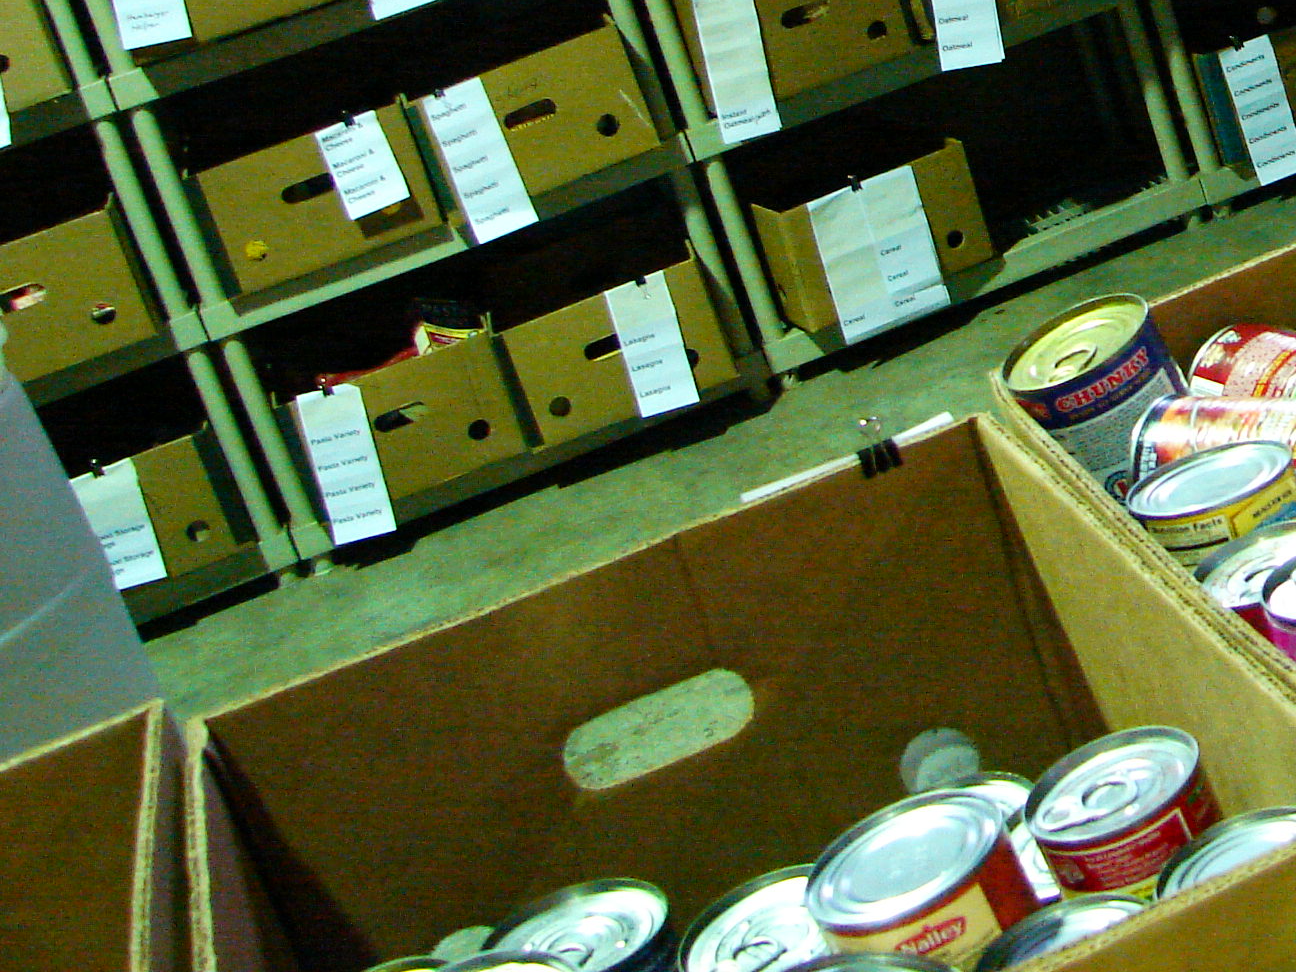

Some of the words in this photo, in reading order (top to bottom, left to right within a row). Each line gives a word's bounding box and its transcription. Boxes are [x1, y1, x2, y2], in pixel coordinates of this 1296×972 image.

[938, 14, 968, 25] Oatmeal
[942, 41, 973, 52] Oatmeal
[332, 151, 367, 169] Macaroni
[337, 164, 364, 178] Cheese
[344, 178, 378, 196] Macaroni
[348, 190, 375, 204] Cheese
[880, 244, 901, 256] Cereal
[887, 270, 908, 282] Cereal
[894, 293, 916, 307] Cereal
[843, 314, 865, 326] Cereal
[1056, 346, 1149, 413] CHUNKY
[334, 429, 360, 440] Variety
[341, 456, 367, 467] Variety
[349, 482, 375, 493] Variety
[356, 509, 382, 520] Variety
[900, 921, 962, 955] Nalley
